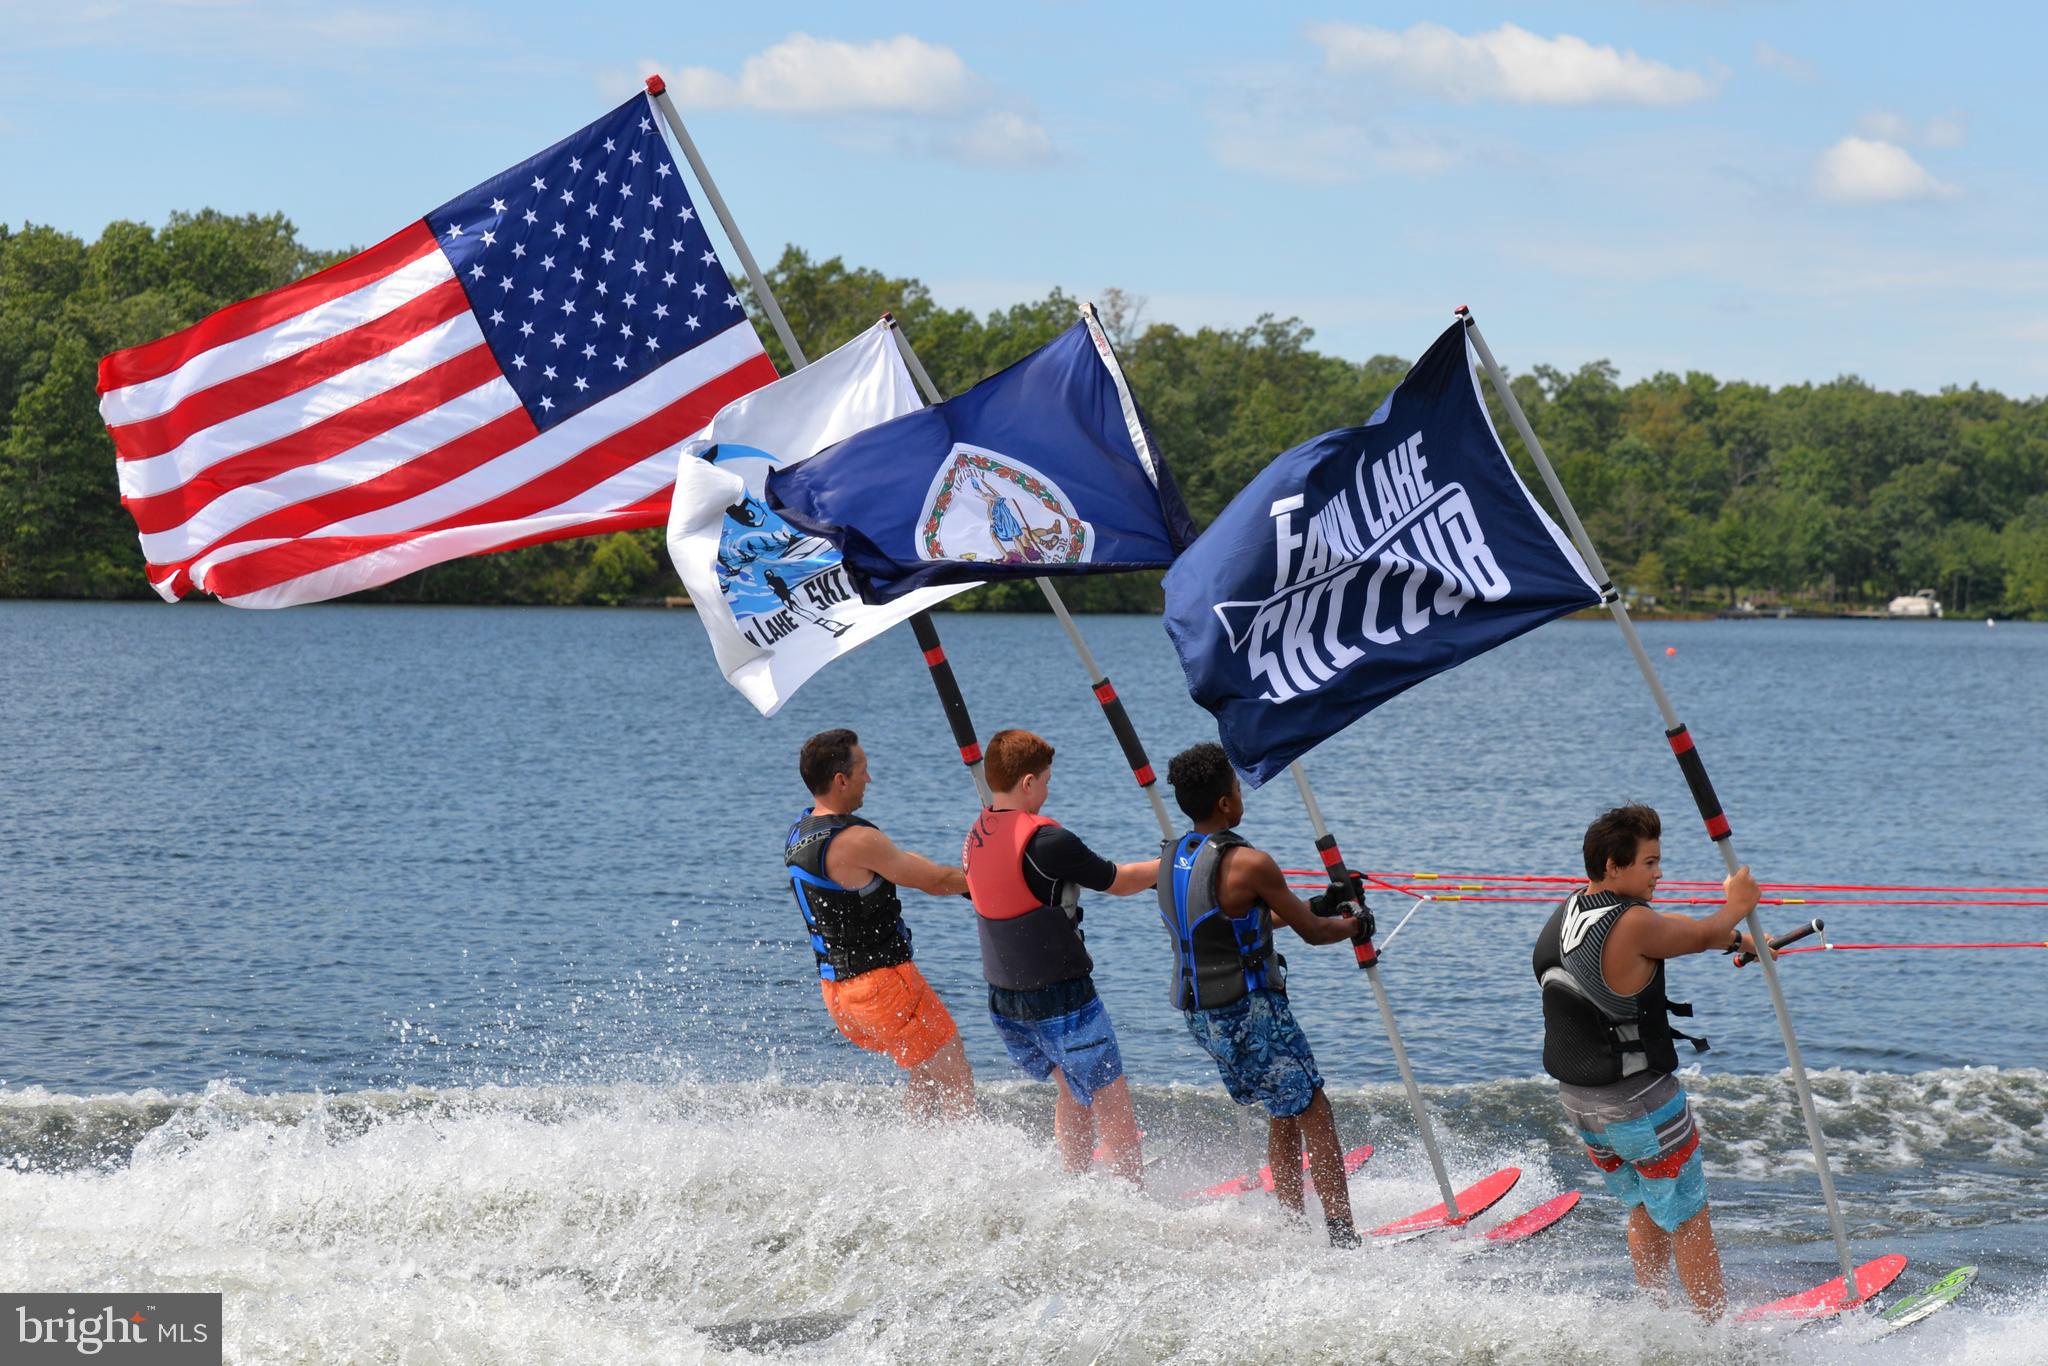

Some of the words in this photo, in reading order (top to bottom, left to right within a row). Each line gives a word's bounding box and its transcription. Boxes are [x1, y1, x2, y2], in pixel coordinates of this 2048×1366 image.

[1269, 489, 1365, 593] FAWN
[1355, 430, 1434, 540] LAKE
[752, 609, 800, 646] LAKE
[803, 567, 851, 611] SKI
[1248, 565, 1366, 705] SKI
[1362, 492, 1512, 645] CLUB
